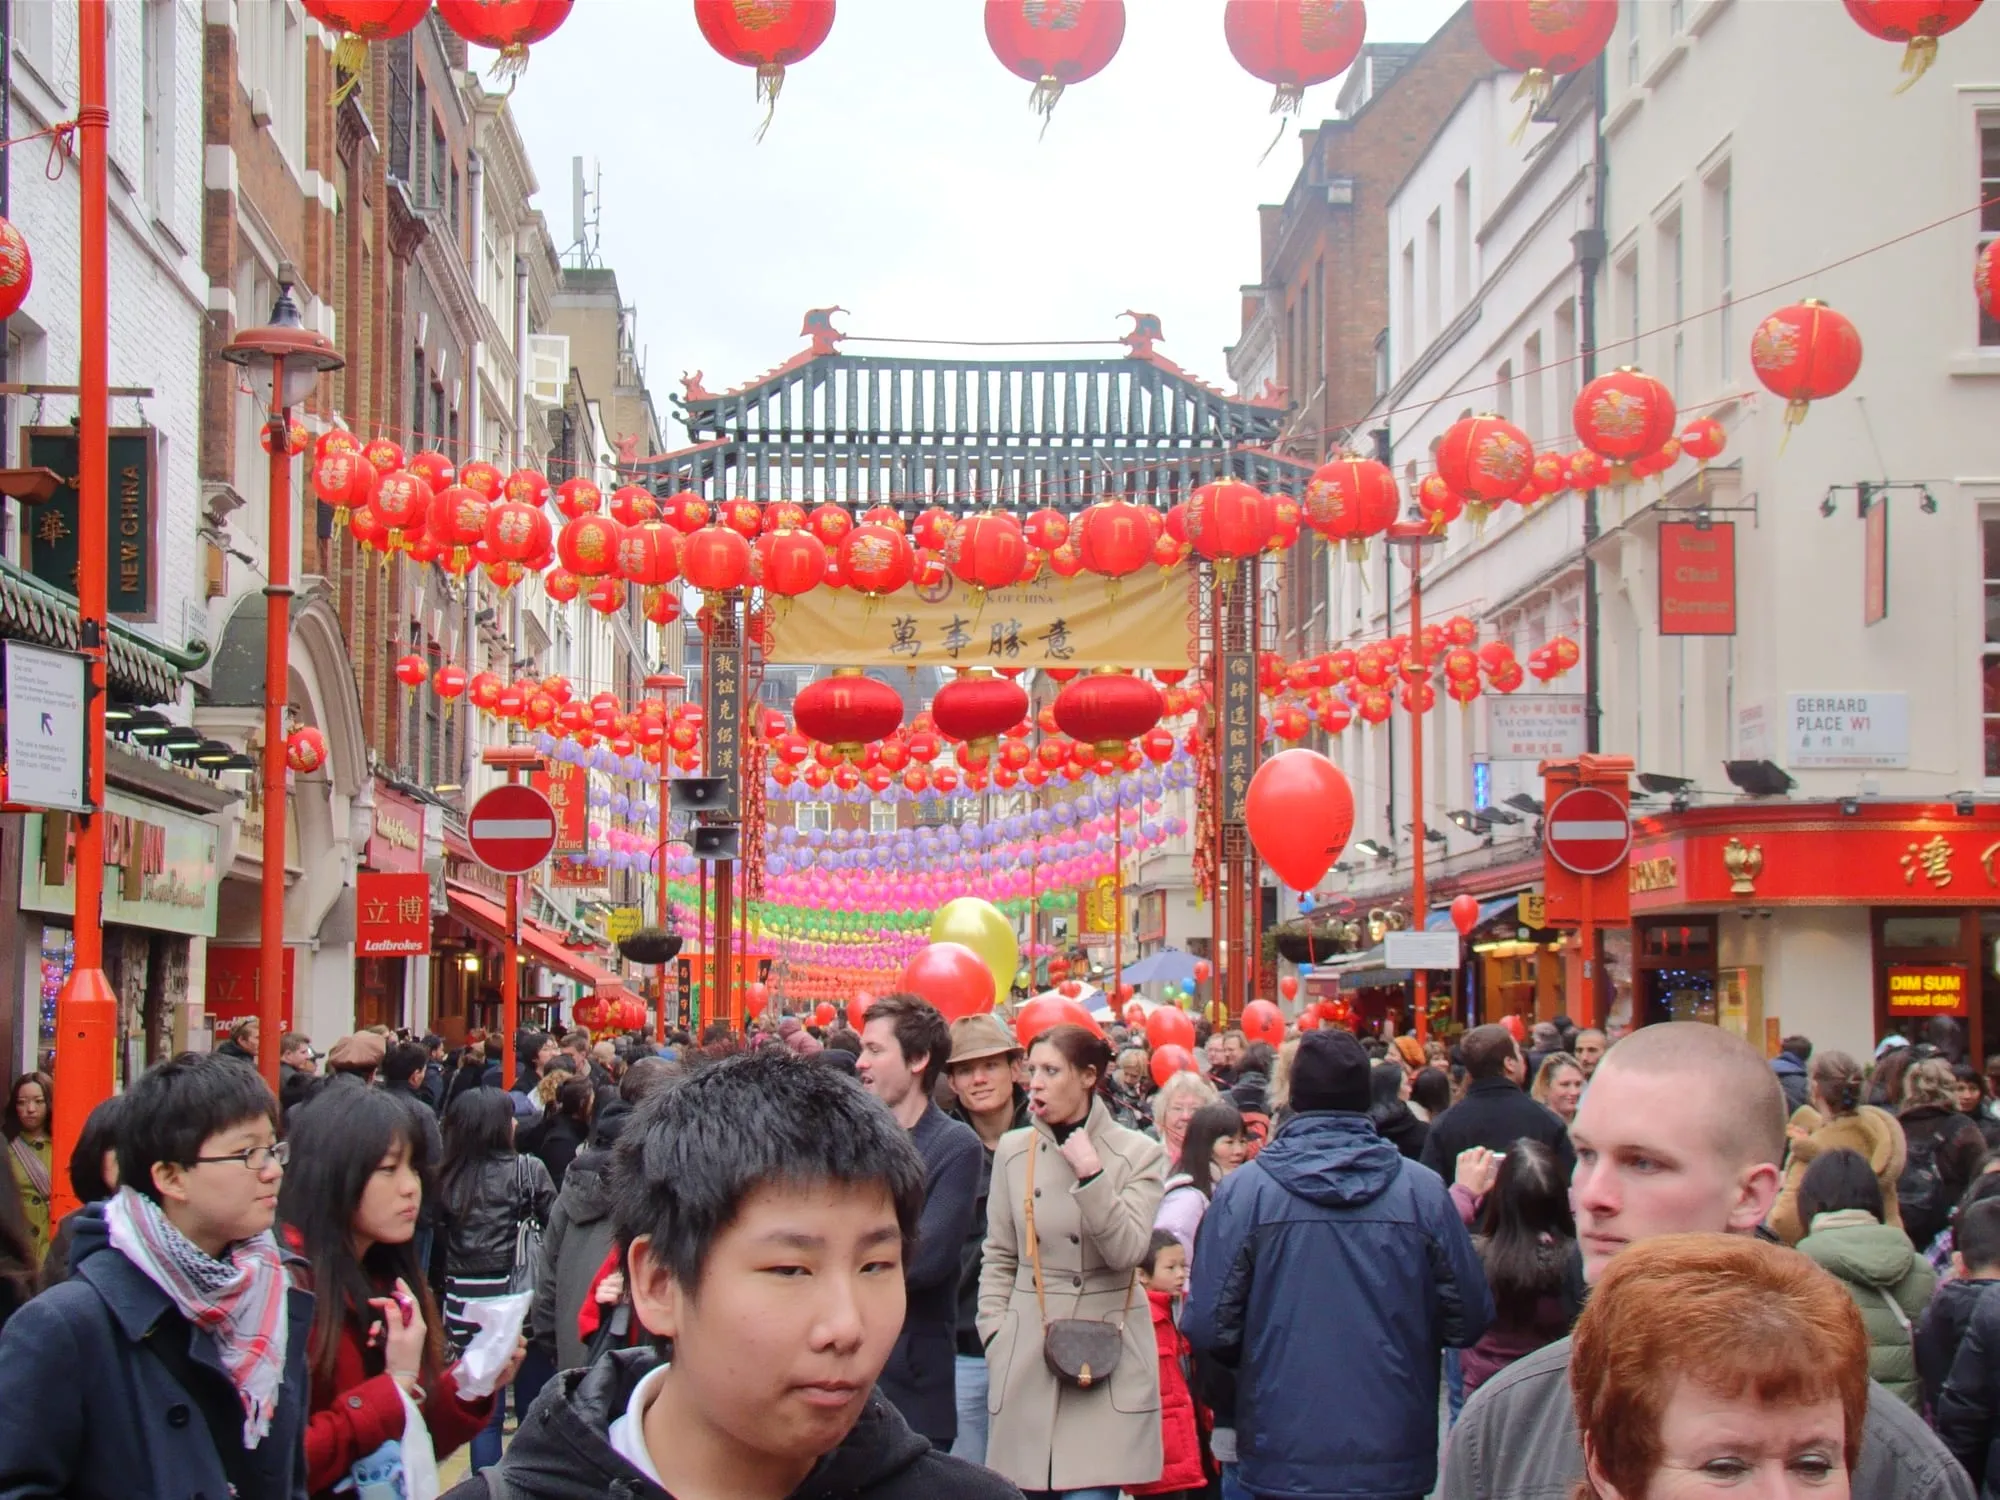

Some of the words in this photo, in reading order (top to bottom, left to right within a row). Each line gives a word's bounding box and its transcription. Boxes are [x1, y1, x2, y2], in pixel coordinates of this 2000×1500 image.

[119, 464, 140, 536] CHINA
[120, 541, 140, 594] NEW
[889, 613, 1076, 661] 萬事勝意
[1796, 698, 1868, 713] GERRARD
[1796, 716, 1843, 731] PLACE
[1849, 716, 1871, 731] W1
[715, 653, 736, 819] 敦誼克紹漢
[362, 896, 424, 925] 立博
[364, 939, 423, 952] Ladbrokes
[1890, 975, 1921, 991] DIM
[1923, 975, 1960, 991] SUM
[1891, 993, 1930, 1007] served
[1932, 993, 1960, 1008] daily
